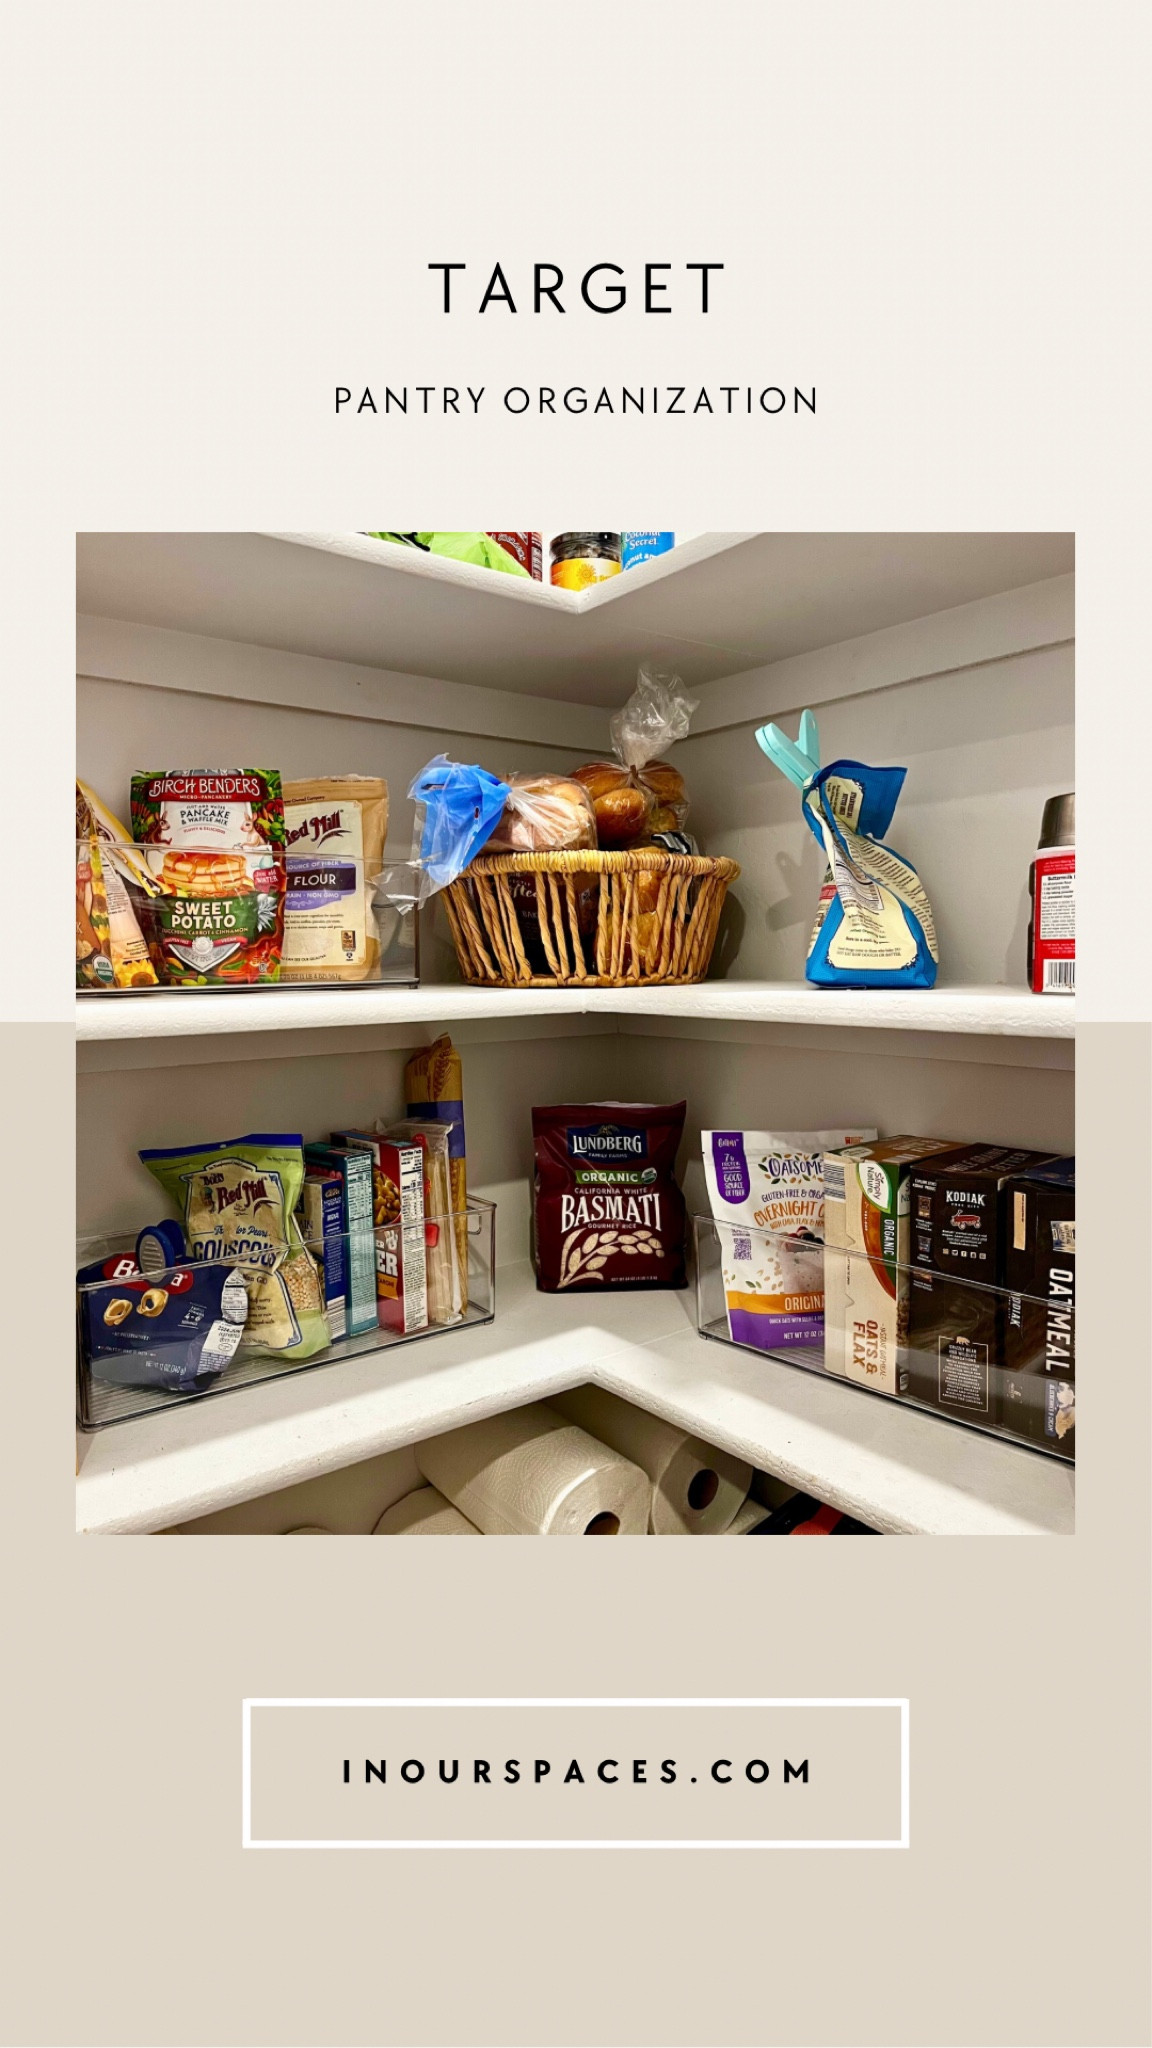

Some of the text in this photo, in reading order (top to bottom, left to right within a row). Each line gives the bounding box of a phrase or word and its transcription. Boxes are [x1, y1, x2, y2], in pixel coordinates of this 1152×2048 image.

[629, 538, 657, 550] Secret
[149, 777, 260, 797] BIRCH BENDERS
[180, 808, 231, 819] PANCAKE
[213, 817, 228, 826] MIX
[309, 809, 342, 842] Mill
[294, 873, 337, 886] FLOUR
[175, 901, 233, 915] SWEET
[171, 914, 236, 929] POTATO
[573, 1135, 642, 1154] LUNDBERG
[581, 1172, 638, 1183] ORGANIC
[724, 1173, 742, 1182] GOOD
[867, 1166, 875, 1194] Nature
[874, 1172, 882, 1200] Simply
[216, 1177, 268, 1214] Red Mill
[574, 1187, 648, 1195] CALIFORNIA WHITE
[761, 1189, 800, 1202] GLUTEN-FREE
[945, 1190, 986, 1206] KODIAK
[560, 1193, 662, 1234] BASMATI
[753, 1201, 818, 1227] OVERNIGHT
[883, 1219, 895, 1256] ORGANIC
[1010, 1292, 1021, 1328] ODIAK
[1046, 1268, 1073, 1371] OATMEAL
[853, 1321, 866, 1368] FLAX
[866, 1320, 878, 1374] OATS &
